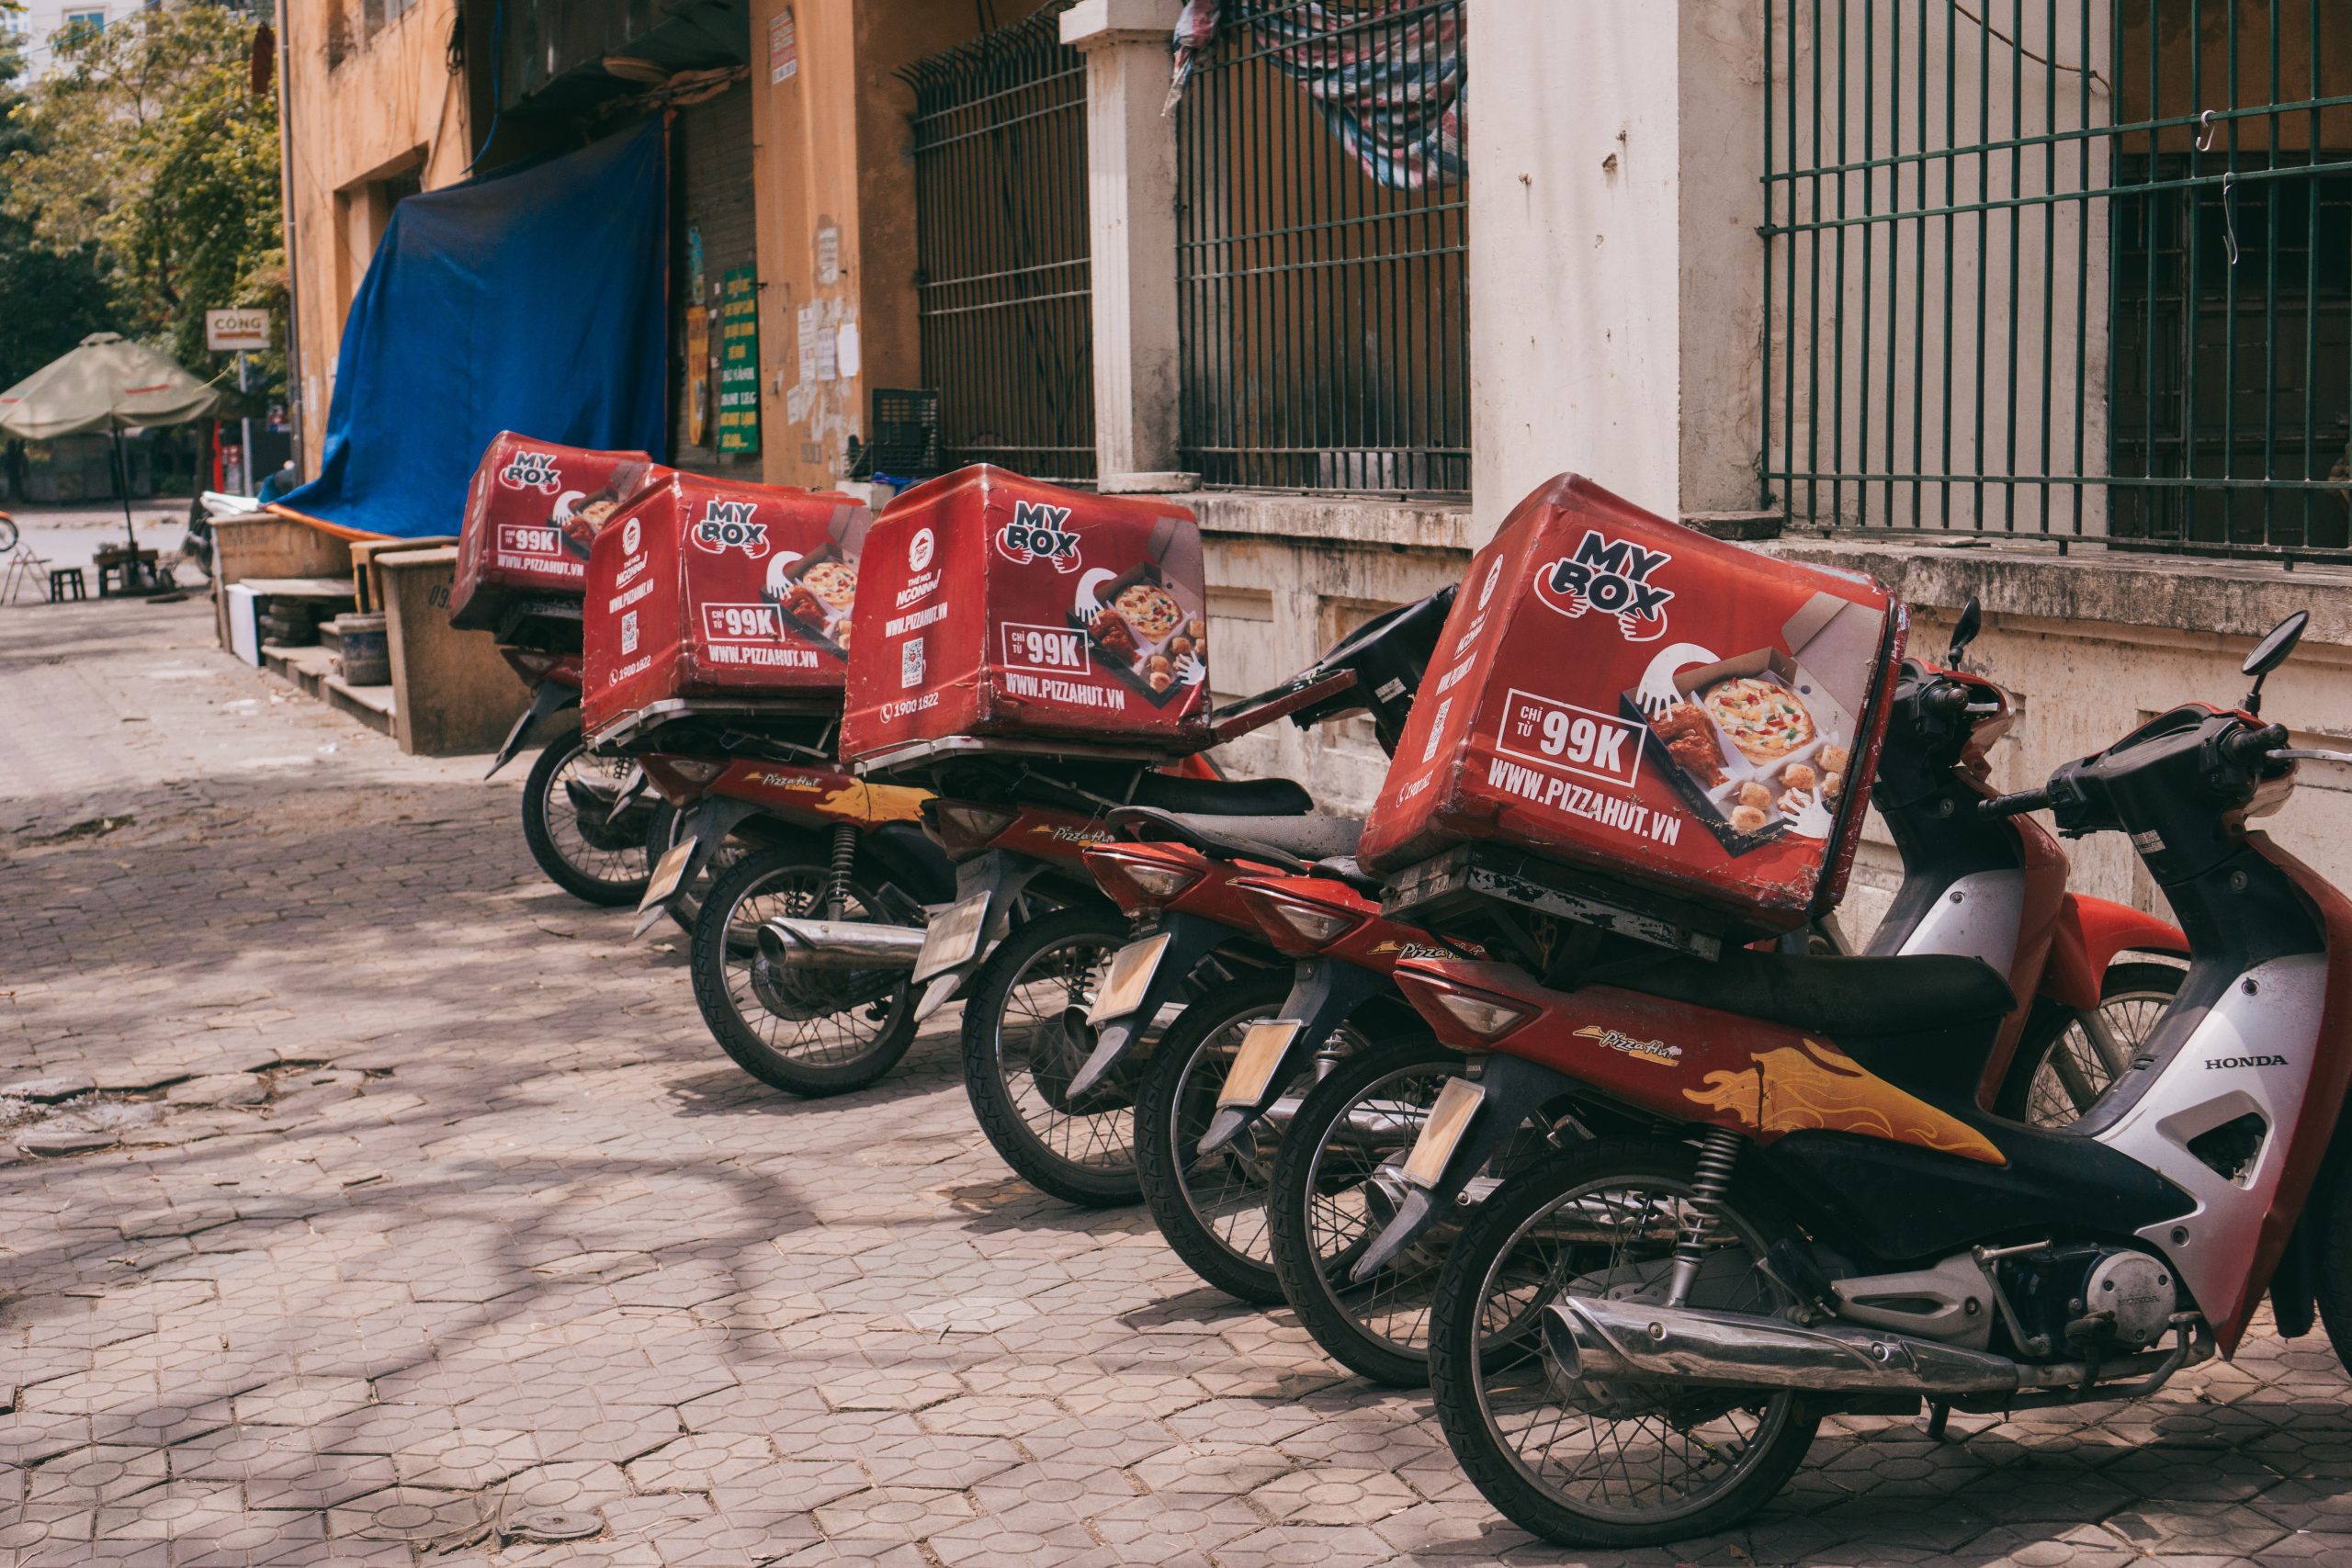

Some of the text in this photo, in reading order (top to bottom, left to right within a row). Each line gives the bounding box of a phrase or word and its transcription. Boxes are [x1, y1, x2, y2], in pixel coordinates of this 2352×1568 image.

[514, 450, 557, 469] MY
[505, 466, 561, 485] BOX
[707, 501, 757, 524] MY
[1015, 502, 1070, 531] MY
[515, 529, 554, 551] 99K
[700, 522, 767, 546] BOX
[1005, 524, 1080, 558] BOX
[498, 554, 584, 577] WWW.PIZZAHUT.VN
[1574, 531, 1670, 583] MY
[1550, 559, 1674, 622] BOX
[725, 608, 775, 636] 99K
[708, 645, 819, 668] WWW.PIZZAHUT.VN
[1026, 631, 1080, 667] 99K
[1005, 672, 1125, 710] WWW.PIZZAHUT.VN
[894, 692, 939, 716] 1900 1822
[1520, 705, 1544, 722] CHỈ
[1517, 721, 1533, 738] TỪ
[1540, 710, 1629, 773] 99K
[763, 773, 794, 786] Pizza
[1487, 757, 1681, 846] WWW.PIZZAHUT.VN
[1053, 826, 1089, 841] Pizza
[1397, 942, 1446, 959] Pizza
[1601, 1031, 1682, 1058] Pizza Hut
[2205, 1055, 2288, 1070] HONDA
